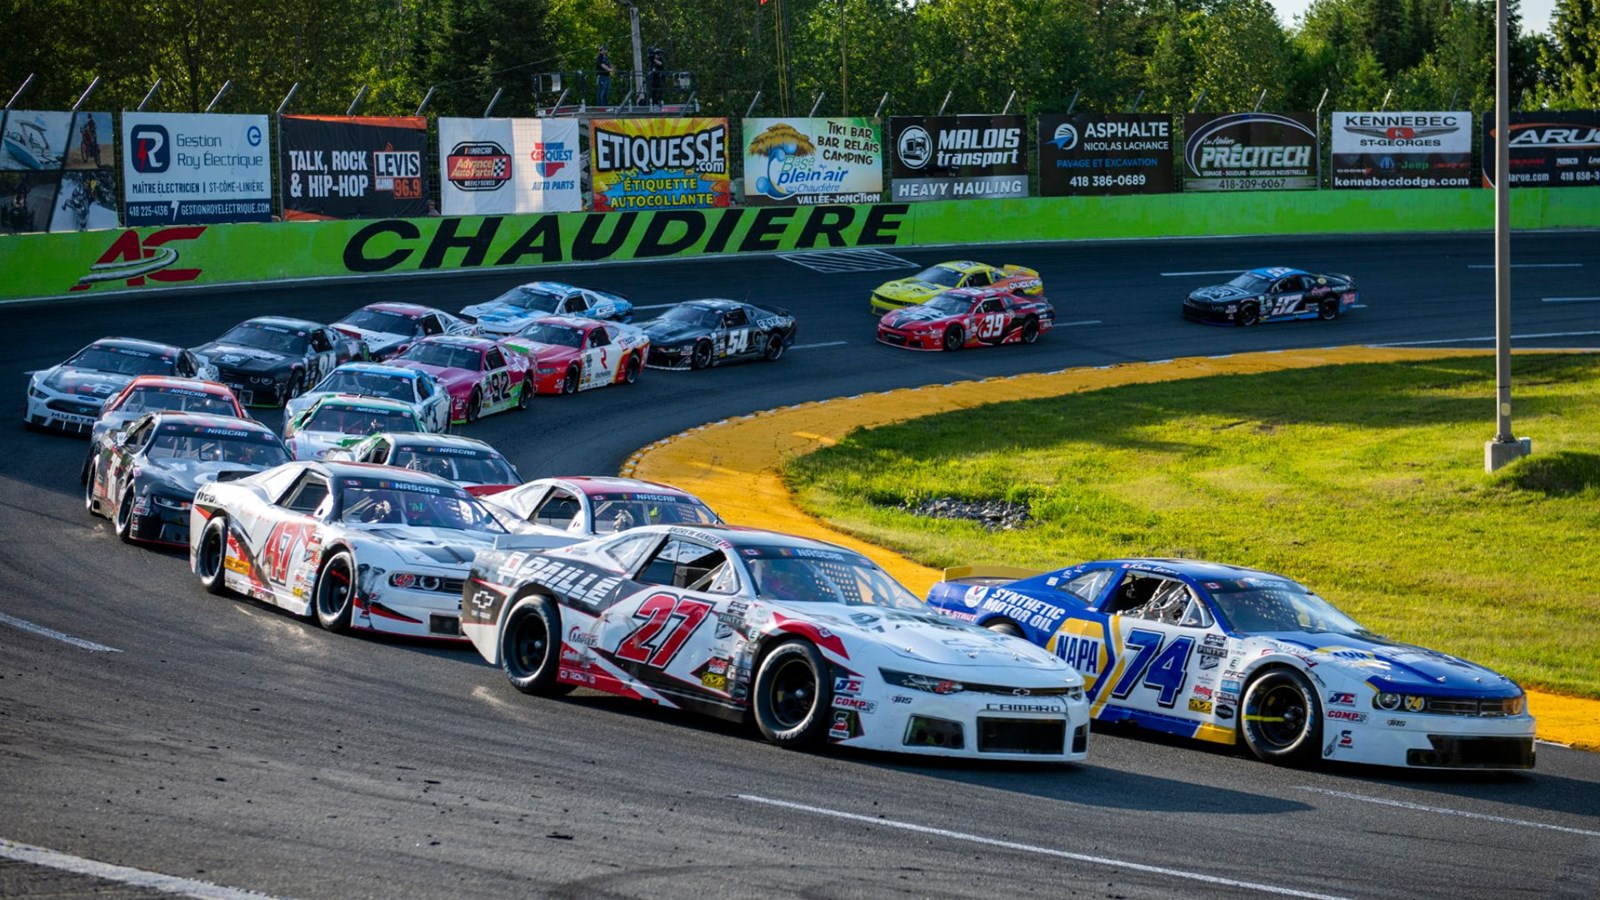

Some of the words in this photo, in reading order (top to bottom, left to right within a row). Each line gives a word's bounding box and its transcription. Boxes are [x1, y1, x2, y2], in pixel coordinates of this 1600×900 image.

[1346, 116, 1457, 126] KENNEBEC
[827, 121, 846, 135] TIKI
[850, 127, 873, 139] BAR
[1084, 122, 1169, 138] ASPHALTE
[1509, 129, 1600, 144] ARU
[176, 133, 222, 148] Gestion
[818, 136, 839, 148] BAR
[844, 140, 880, 153] RELAIS
[938, 128, 1021, 150] MALOIS
[1360, 139, 1441, 147] ST-GEORGES
[596, 127, 724, 172] ETIQUESSE
[696, 161, 724, 172] .com
[1084, 142, 1121, 151] NICOLAS
[1124, 141, 1169, 150] LACHANCE
[177, 153, 200, 170] Roy
[204, 150, 263, 168] Électrique
[531, 149, 573, 161] CARQUEST
[823, 150, 873, 165] CAMPING
[937, 149, 1019, 168] transport
[1200, 143, 1311, 168] PRÉCITECH
[289, 150, 328, 174] TALK,
[332, 150, 368, 171] ROCK
[375, 153, 419, 177] LEVIS
[456, 158, 492, 168] Advance
[1057, 159, 1090, 168] PAVAGE
[1092, 159, 1102, 167] ET
[1105, 158, 1158, 167] EXCAVATION
[1401, 161, 1429, 170] Jeep
[450, 168, 472, 177] Auto
[471, 168, 493, 177] Parts
[777, 168, 820, 185] plein
[823, 166, 849, 182] air
[1509, 173, 1549, 182] larue.com
[132, 181, 156, 194] MAÎTRE
[158, 180, 200, 194] ÉLECTRICIEN
[290, 173, 302, 198] &
[308, 175, 369, 198] HIP-HOP
[532, 181, 550, 191] AUTO
[552, 180, 575, 190] PARTS
[624, 177, 697, 192] ÉTIQUETTE
[1069, 176, 1089, 187] 418
[1092, 174, 1146, 186] 386-0689
[1220, 179, 1286, 189] 418-209-6067
[1335, 177, 1469, 187] kennebecdodge.com
[394, 179, 421, 197] 96.9
[797, 183, 840, 193] Chaudière
[898, 183, 949, 197] HEAVY
[953, 181, 1022, 195] HAULING
[610, 193, 714, 208] AUTOCOLLANTE
[797, 193, 880, 205] VALLÉE-JONCTION
[181, 203, 270, 216] GESTIONROYELECTRIQUE.COM
[343, 203, 911, 273] CHAUDIERE
[1272, 294, 1303, 316] 97
[983, 314, 1005, 337] 39
[727, 329, 748, 355] 54
[120, 349, 150, 358] NASCAR
[170, 388, 208, 398] NASCAR
[51, 412, 97, 423] MUSTA
[356, 407, 390, 415] NASCAR
[208, 427, 248, 438] NASCAR
[440, 447, 476, 456] NASCAR
[394, 483, 440, 494] NASCAR
[636, 494, 676, 502] NASCAR
[265, 520, 300, 586] 47
[797, 548, 843, 561] NASCAR
[991, 588, 1066, 620] SYNTHETIC
[983, 598, 1028, 624] MOTOR
[1029, 614, 1056, 633] OIL
[614, 591, 716, 670] 27
[1056, 635, 1099, 674] NAPA
[1199, 646, 1227, 658] PINTY'S
[1111, 627, 1196, 709] 74
[1223, 670, 1246, 678] PFC
[835, 680, 861, 691] JE
[834, 697, 866, 707] COMP
[1328, 693, 1355, 703] JE
[986, 703, 1061, 712] CAMARO
[1327, 711, 1358, 720] COMP
